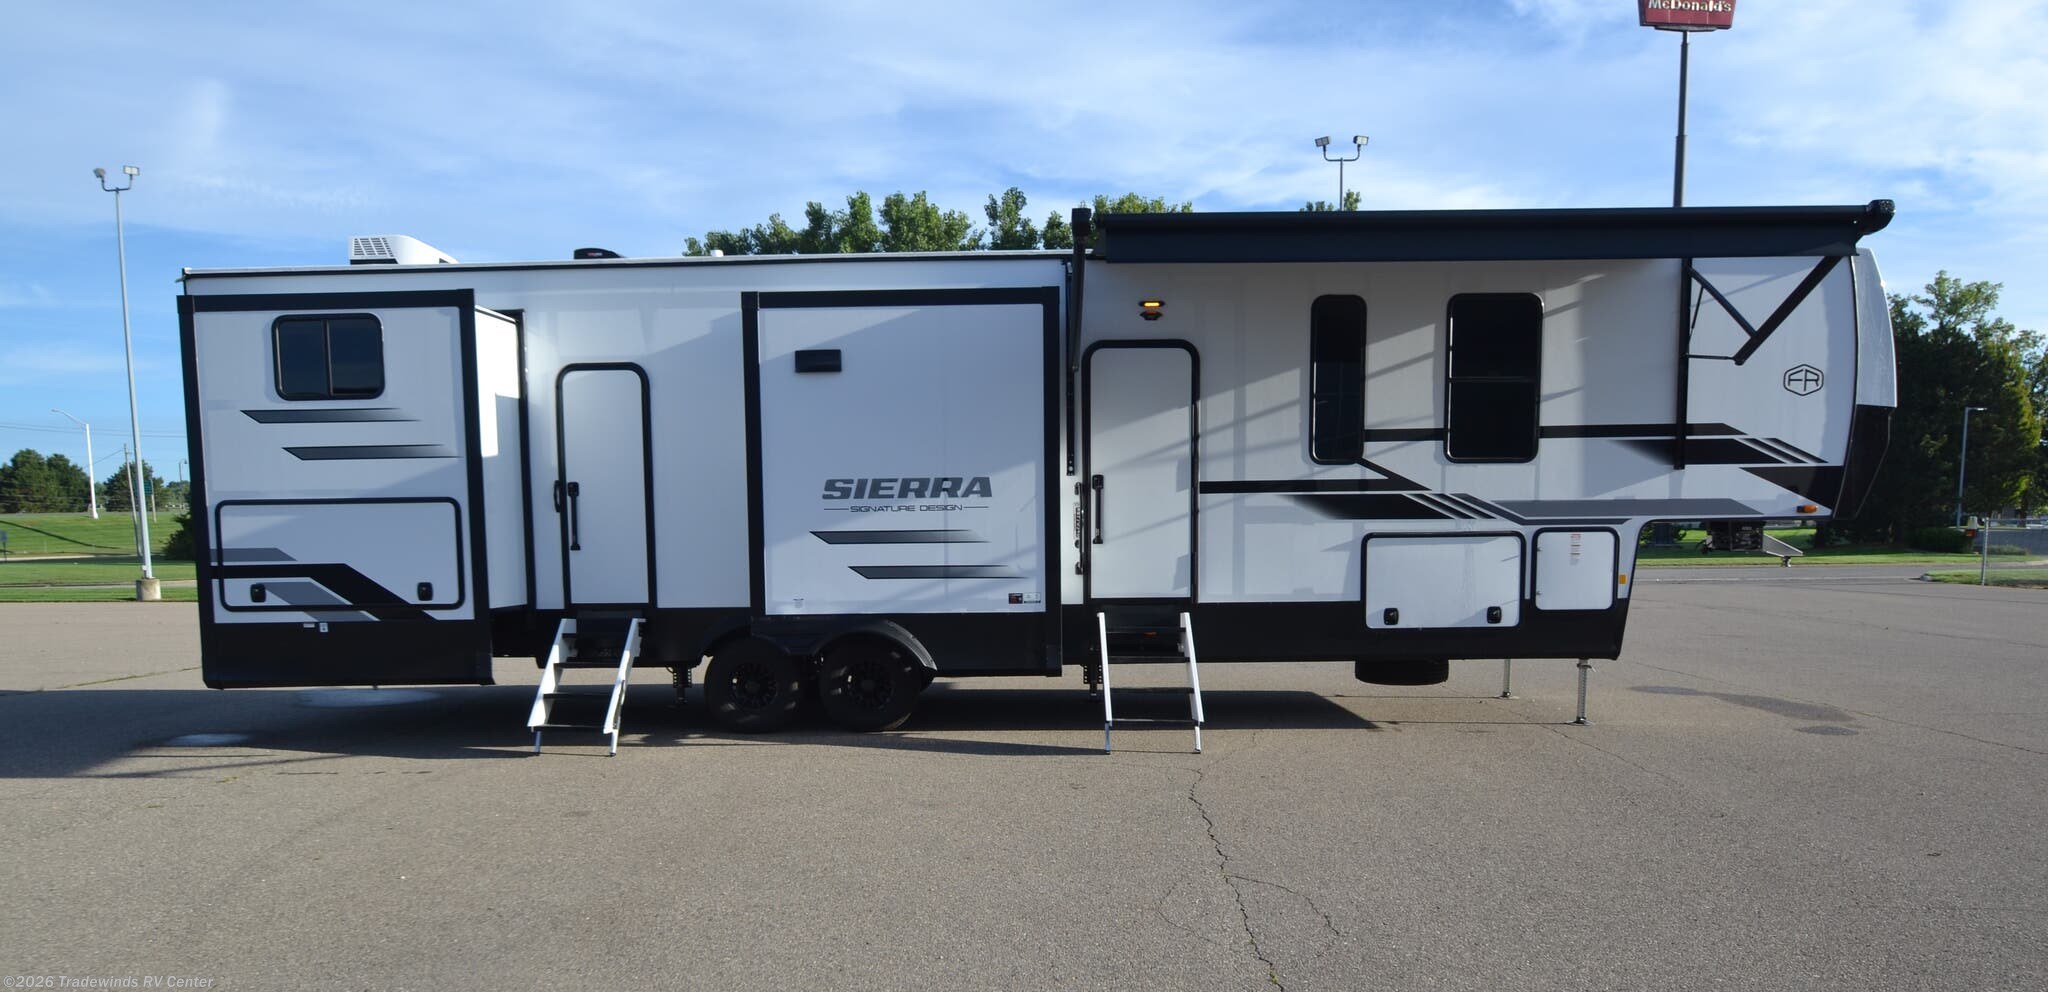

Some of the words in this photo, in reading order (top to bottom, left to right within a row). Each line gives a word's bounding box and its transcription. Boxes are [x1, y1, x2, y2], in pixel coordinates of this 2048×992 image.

[1648, 0, 1732, 12] McDonald's
[1787, 368, 1820, 392] FR
[822, 476, 993, 500] SIERRA
[850, 505, 916, 513] SIGNATURE
[919, 504, 963, 512] DESIGN
